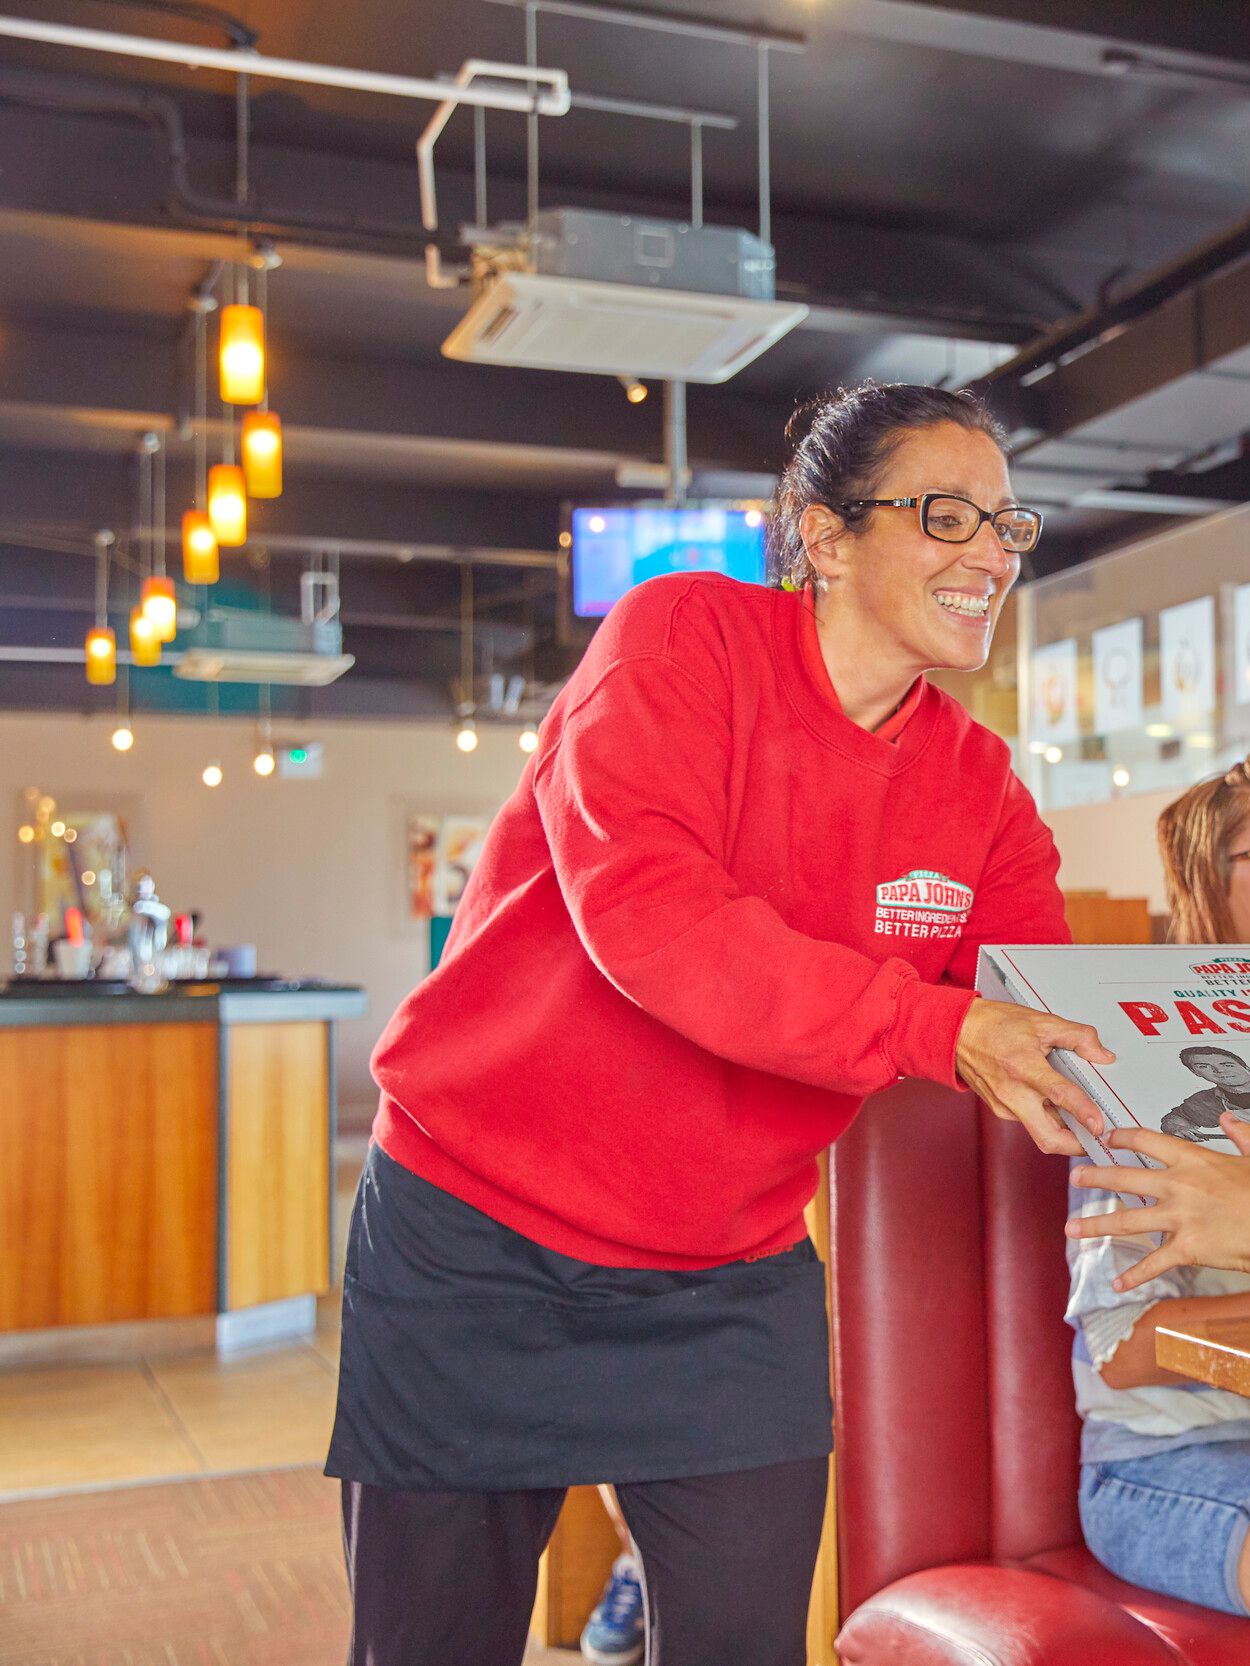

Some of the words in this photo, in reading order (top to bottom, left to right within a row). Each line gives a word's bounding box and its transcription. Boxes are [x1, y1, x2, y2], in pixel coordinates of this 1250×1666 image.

[880, 882, 921, 902] PAPA
[876, 907, 915, 922] BETTER
[874, 920, 929, 938] BETTER
[1193, 963, 1236, 974] PAPA
[1173, 989, 1237, 998] QUALITY
